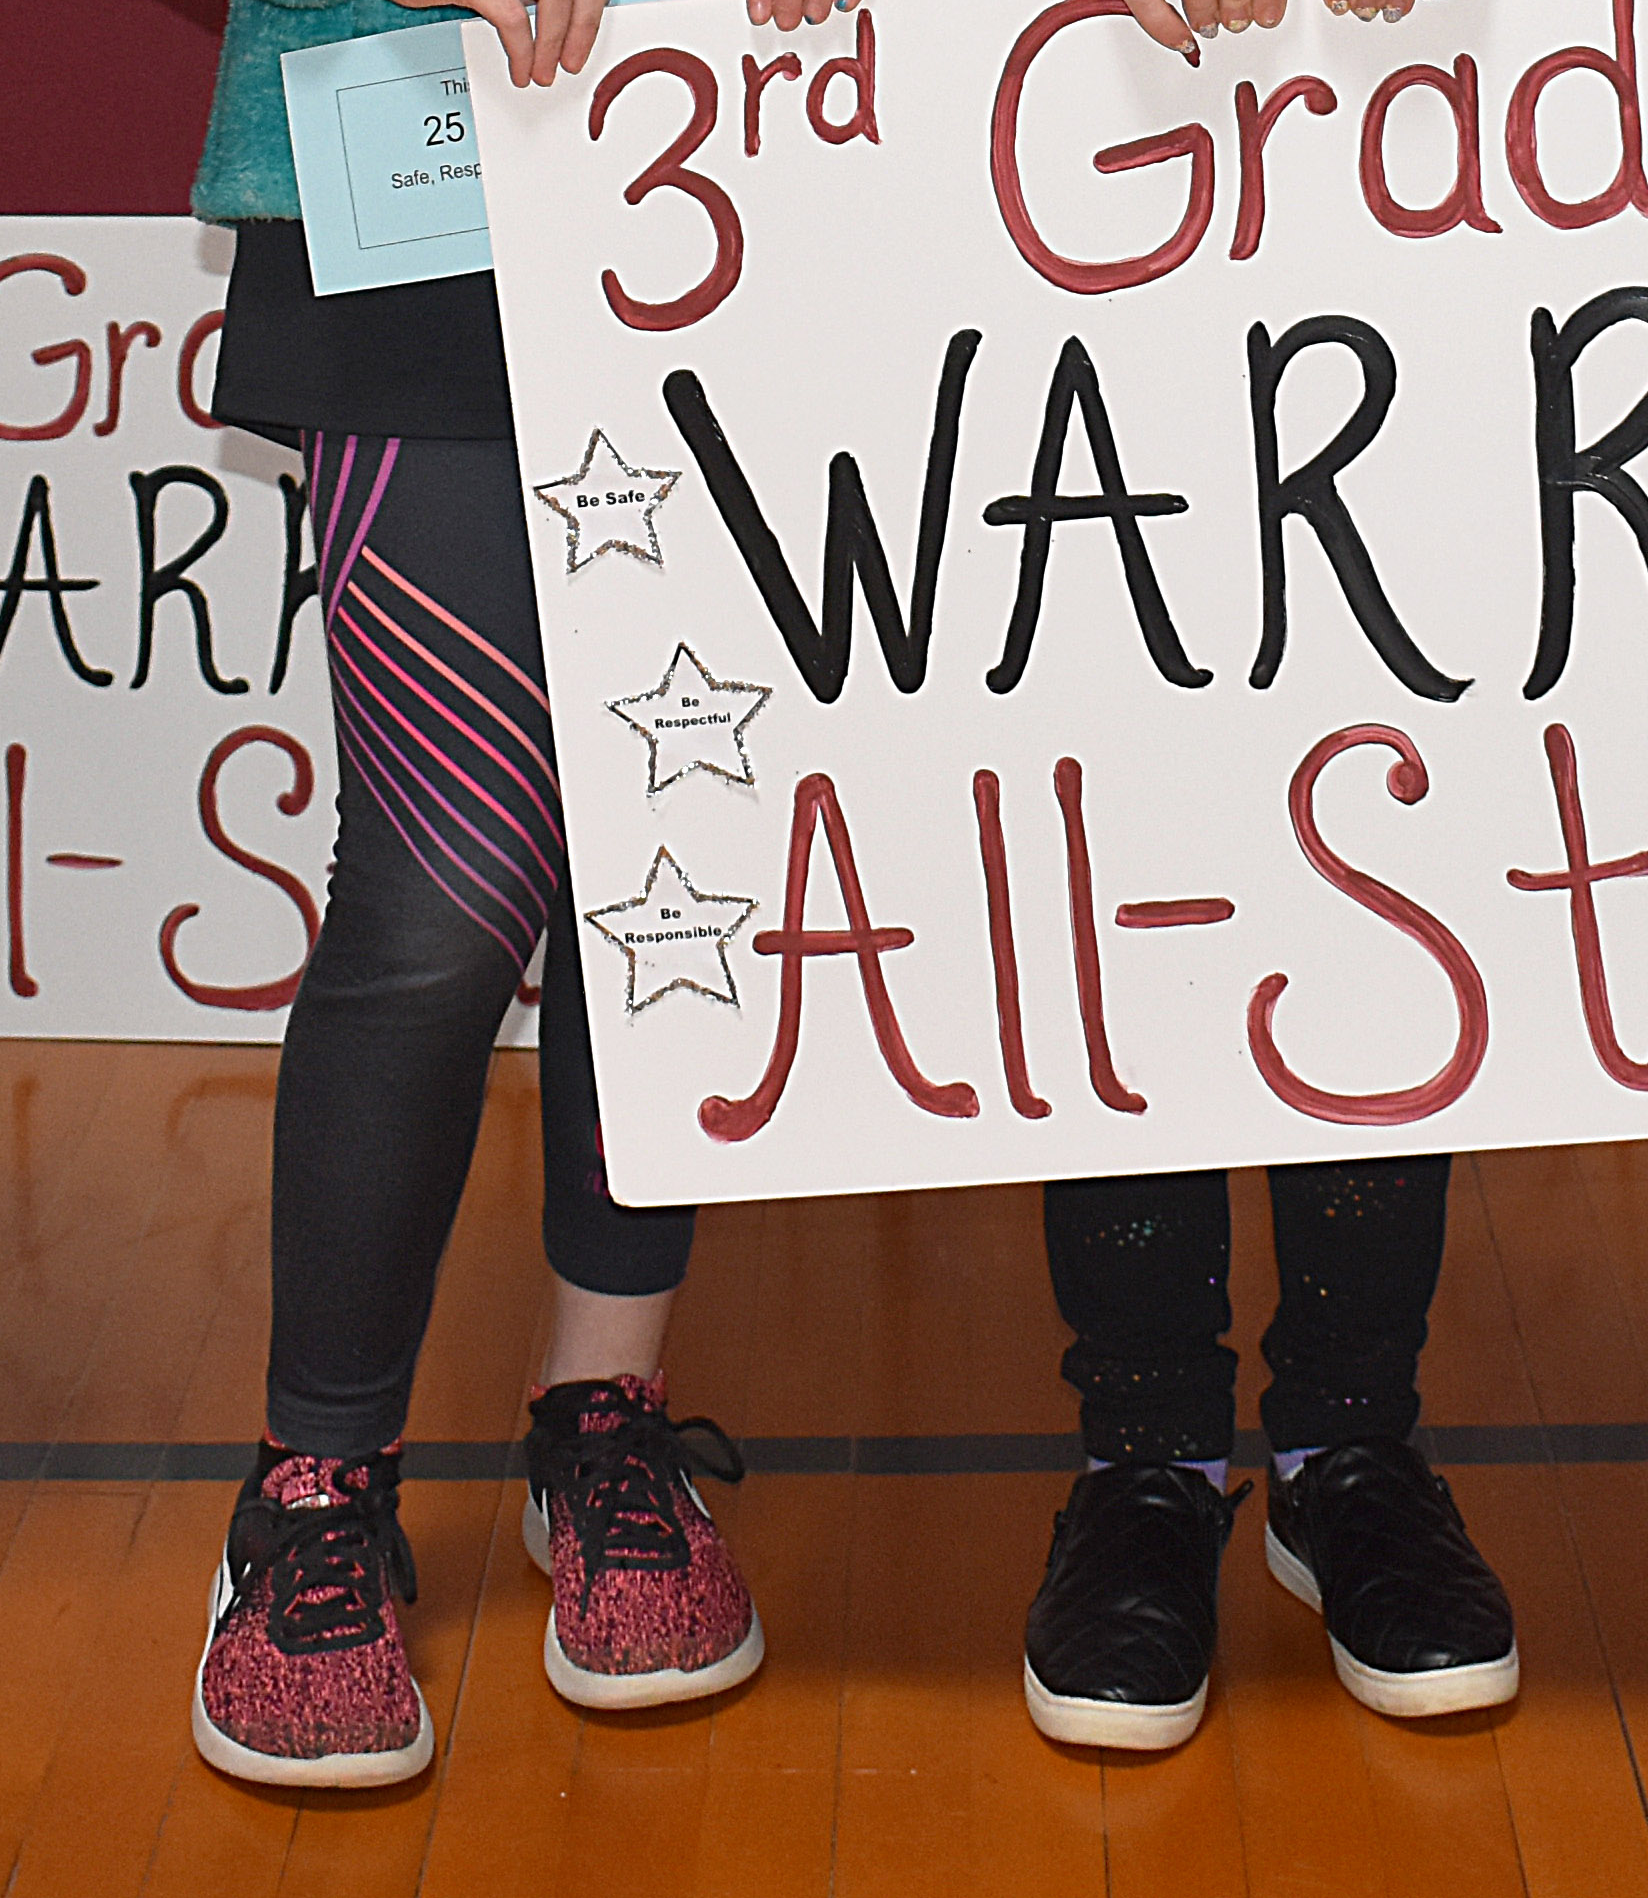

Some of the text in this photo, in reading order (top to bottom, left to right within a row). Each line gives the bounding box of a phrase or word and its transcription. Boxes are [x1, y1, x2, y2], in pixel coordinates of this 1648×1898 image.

[440, 78, 470, 96] Thi
[423, 111, 465, 147] 25
[391, 166, 435, 189] Safe,
[589, 7, 882, 332] 3rd
[576, 488, 646, 509] Be Safe
[681, 695, 700, 708] Be
[654, 712, 732, 730] Respectful
[660, 908, 681, 921] Be
[624, 925, 722, 944] Responsible
